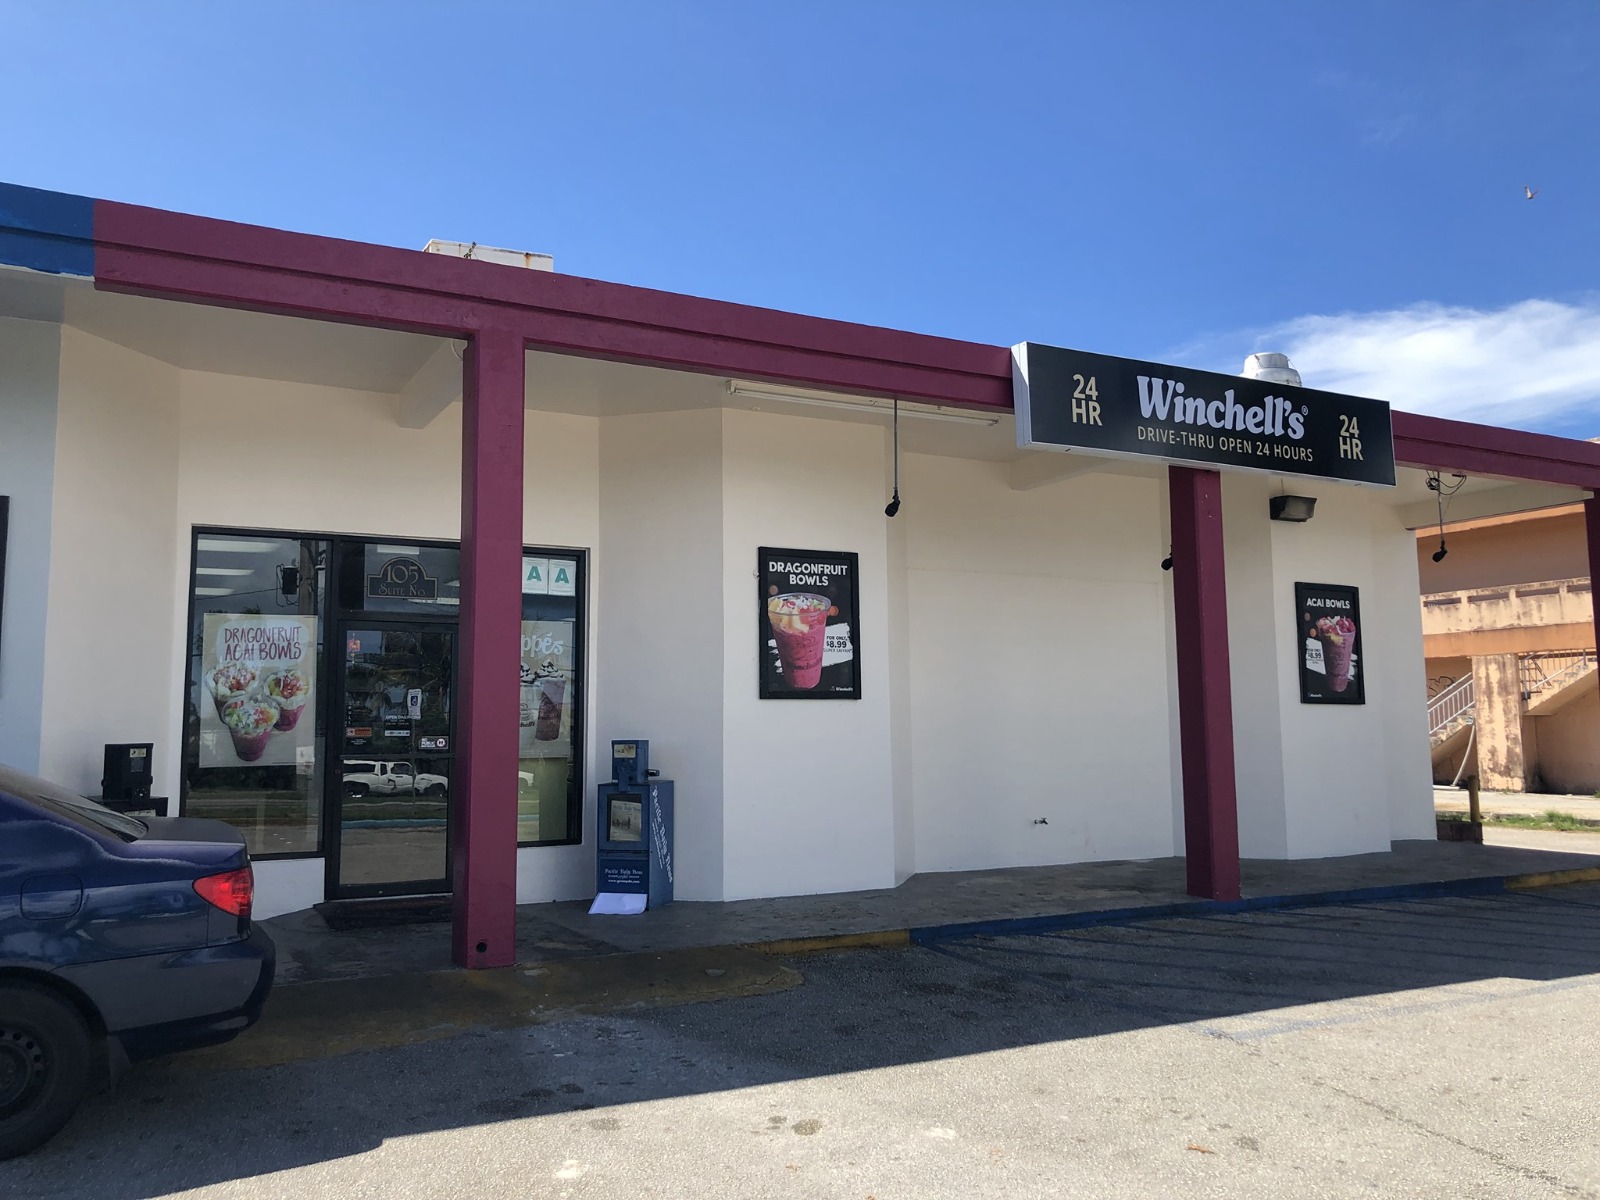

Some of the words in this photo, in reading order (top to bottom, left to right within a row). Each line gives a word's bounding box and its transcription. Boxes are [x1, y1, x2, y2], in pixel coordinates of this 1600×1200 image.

[1072, 374, 1099, 400] 24
[1071, 399, 1103, 426] HR
[1339, 415, 1360, 438] 24
[1138, 425, 1214, 450] DRIVE-THRU
[1219, 437, 1252, 455] OPEN
[1256, 442, 1270, 457] 24
[1274, 444, 1313, 462] HOURS
[1339, 436, 1363, 461] HR
[385, 565, 418, 584] 105
[526, 565, 542, 582] A
[554, 568, 570, 584] A
[769, 561, 848, 576] DRAGONFRUIT
[789, 574, 829, 587] BOWLS
[1306, 597, 1325, 608] ACAI
[1325, 599, 1351, 609] BOWLS
[224, 626, 302, 644] DRAGONFRUIT
[224, 642, 255, 661] ACAI
[259, 641, 302, 660] BOWLS
[826, 640, 847, 649] $8.99
